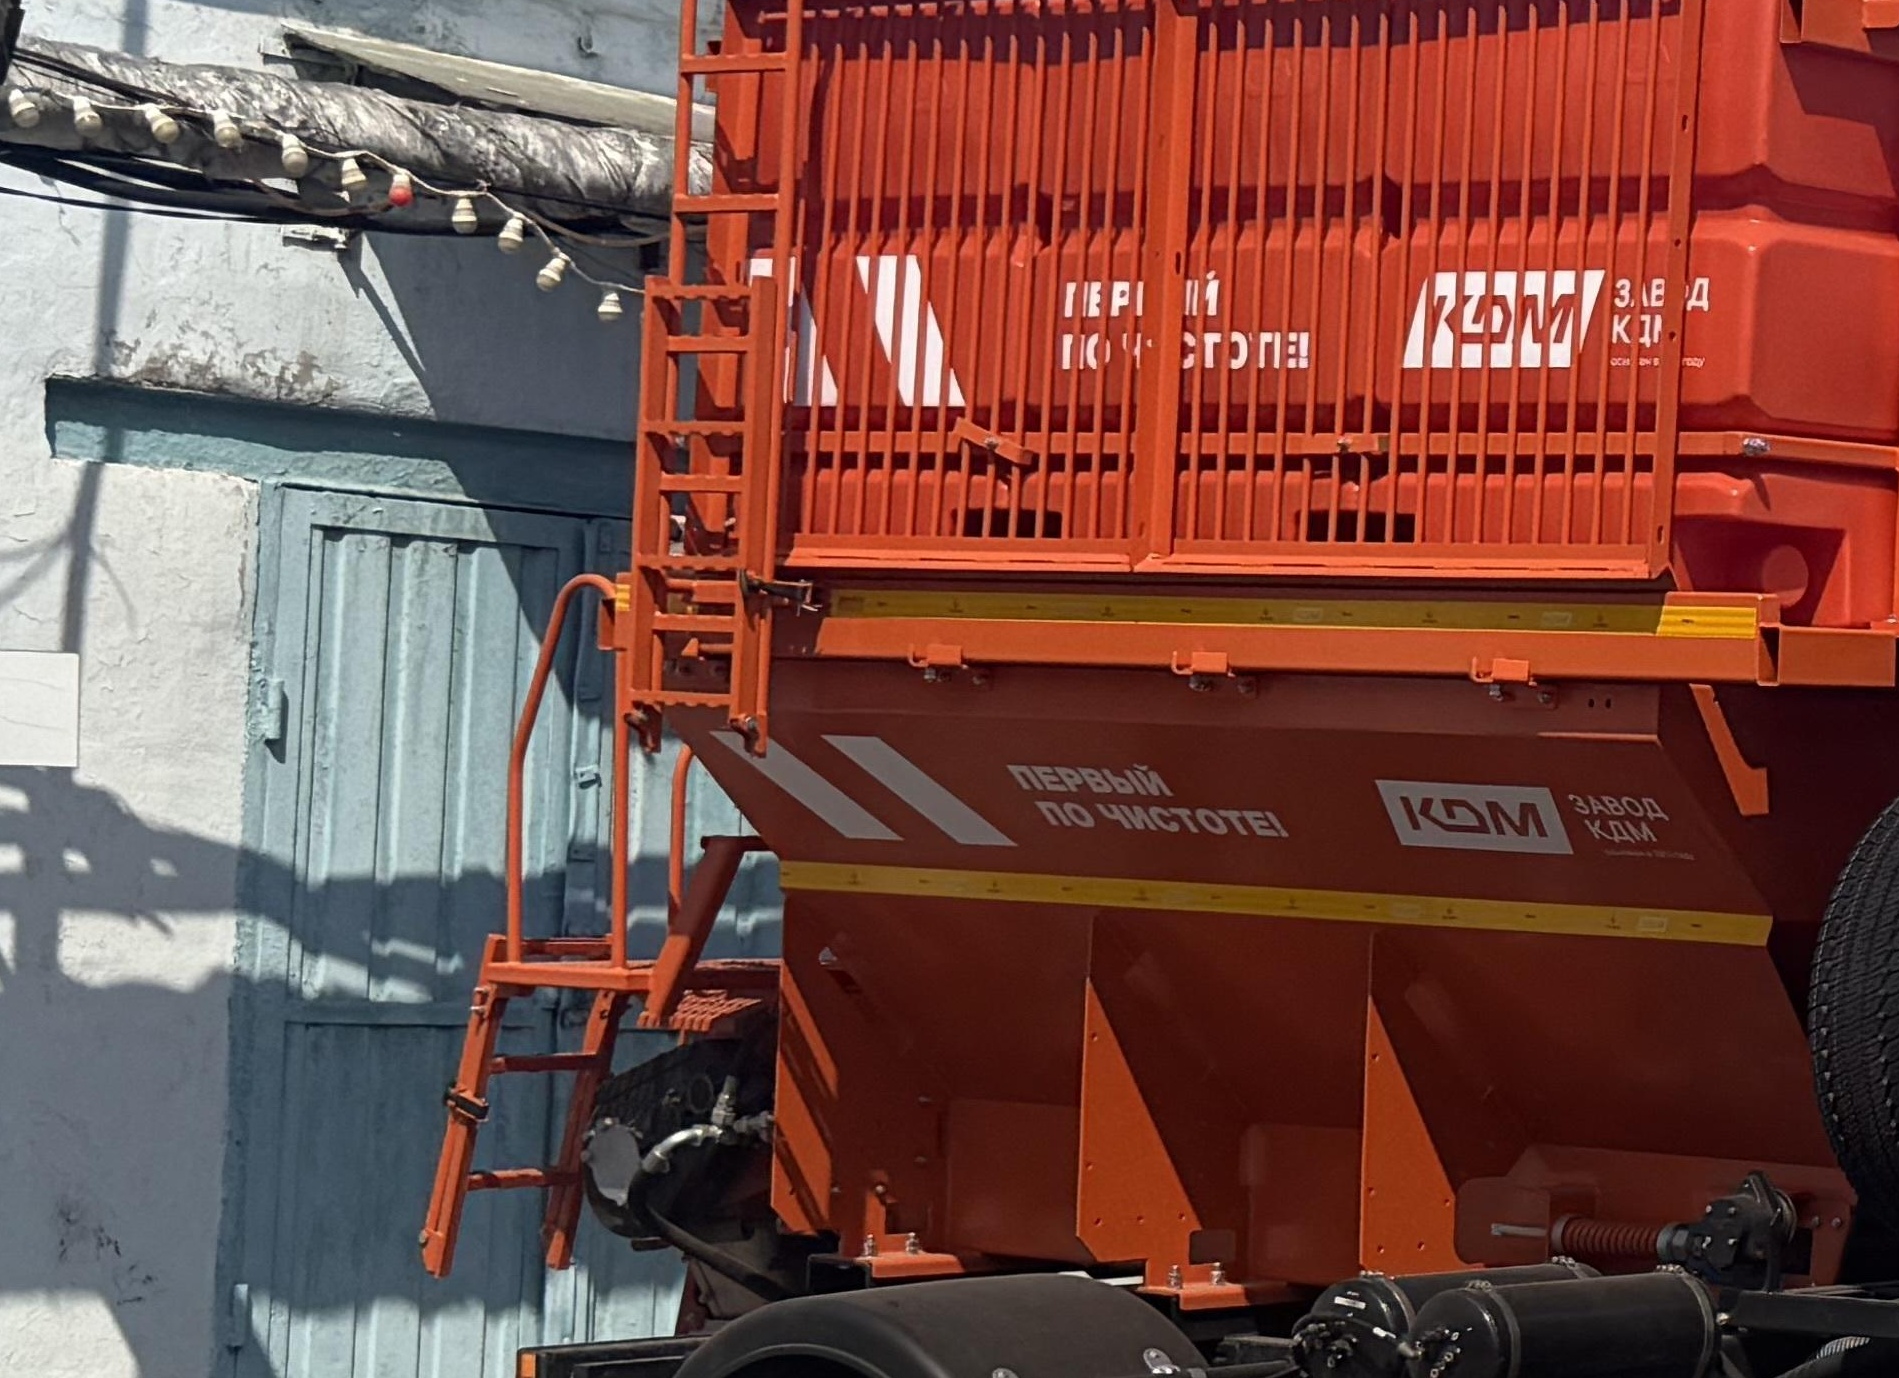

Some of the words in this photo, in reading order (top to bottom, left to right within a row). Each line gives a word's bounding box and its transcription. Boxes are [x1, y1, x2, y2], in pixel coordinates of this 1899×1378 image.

[1614, 278, 1710, 311] ЗАВД
[1006, 763, 1174, 797] ПЕРВЫЙ
[1034, 800, 1096, 828] ПО
[1096, 803, 1290, 838] ЧИСТОТЕ!
[1398, 795, 1549, 838] KDM
[1568, 793, 1669, 821] ЗАВОД
[1583, 819, 1658, 844] КДМ
